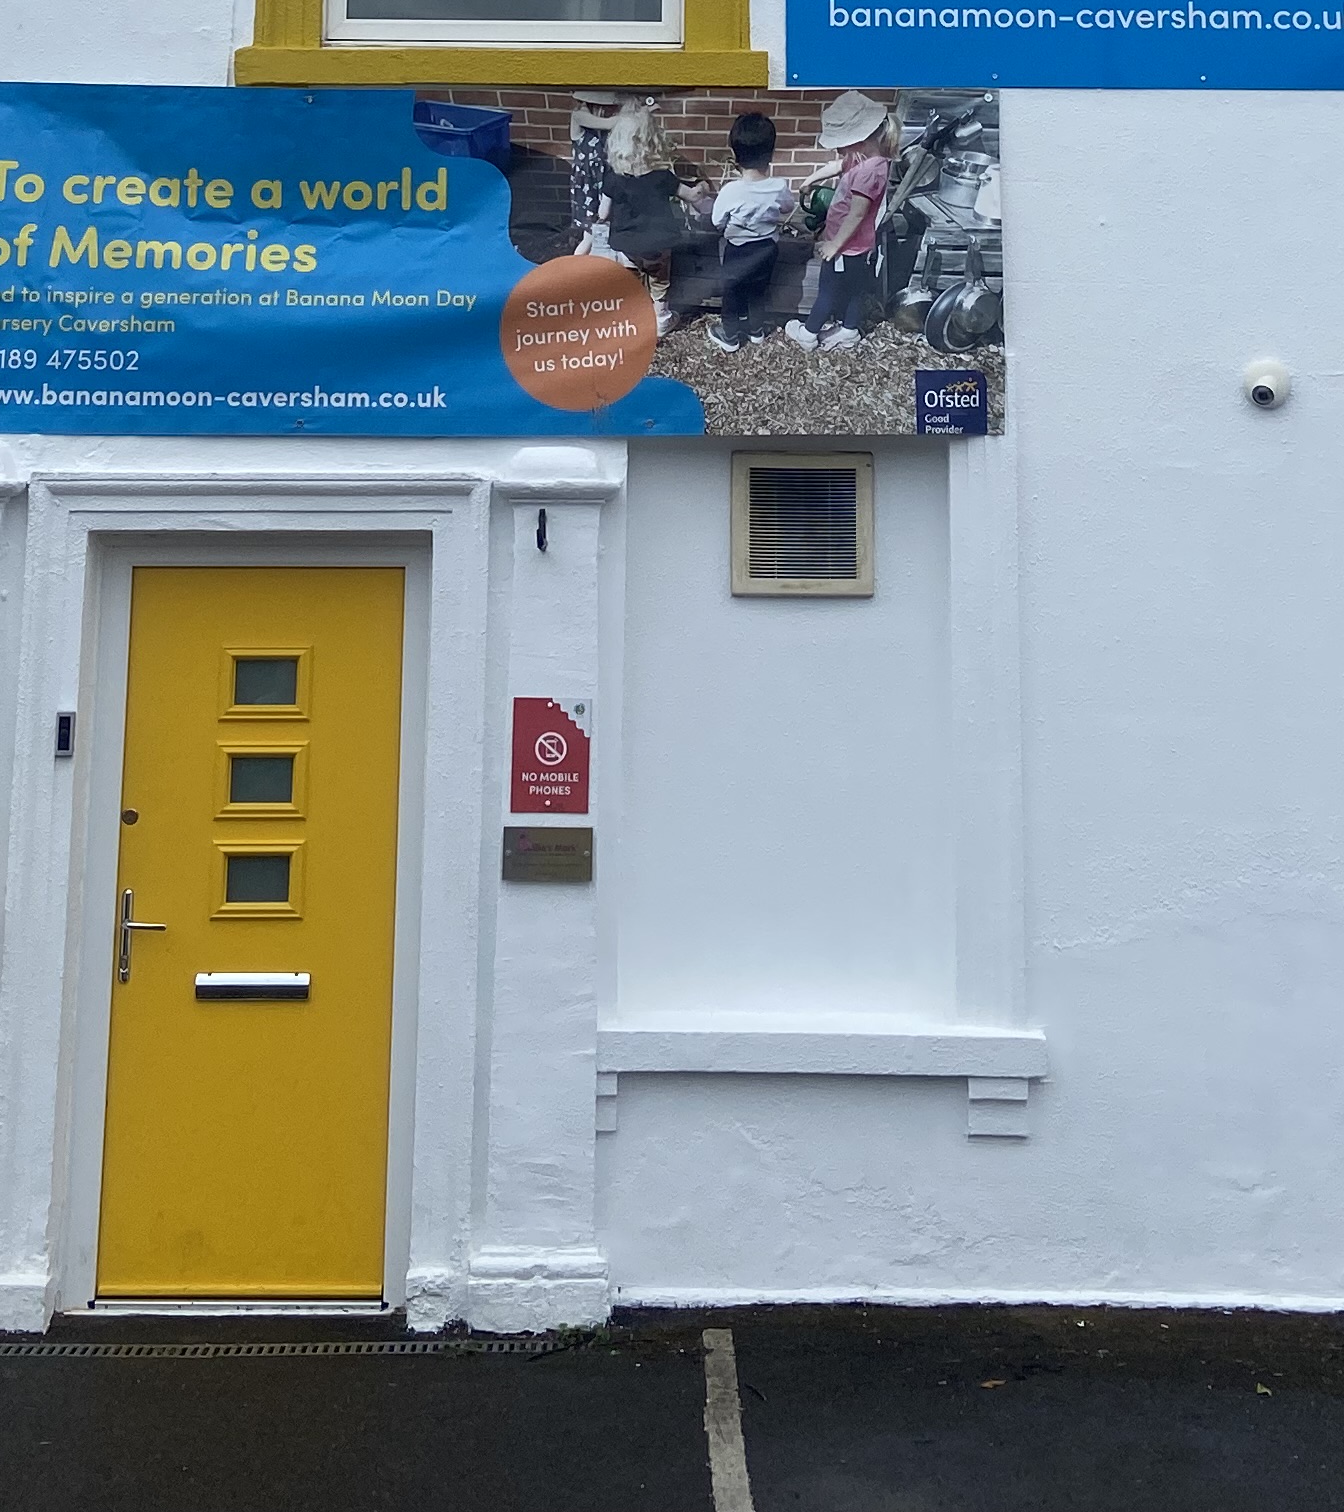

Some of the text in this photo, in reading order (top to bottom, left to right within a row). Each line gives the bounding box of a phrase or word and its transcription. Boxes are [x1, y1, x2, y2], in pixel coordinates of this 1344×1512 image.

[62, 168, 232, 209] create
[252, 176, 283, 210] a
[300, 166, 448, 212] world
[48, 226, 318, 273] Memories
[21, 288, 40, 304] to
[47, 287, 115, 308] inspire
[122, 292, 134, 304] a
[140, 288, 252, 310] generation
[259, 290, 280, 306] at
[286, 290, 364, 307] Banana
[372, 290, 430, 308] Moon
[437, 291, 476, 312] Day
[526, 297, 624, 318] Start your
[58, 316, 176, 333] Caversham
[515, 320, 637, 351] journey with
[46, 349, 140, 372] 475502
[534, 348, 624, 372] us today!
[924, 389, 979, 408] Ofsted
[925, 413, 949, 423] Good
[925, 425, 964, 434] Provider
[522, 772, 579, 782] NO MOBILE
[529, 786, 571, 795] PHONES
